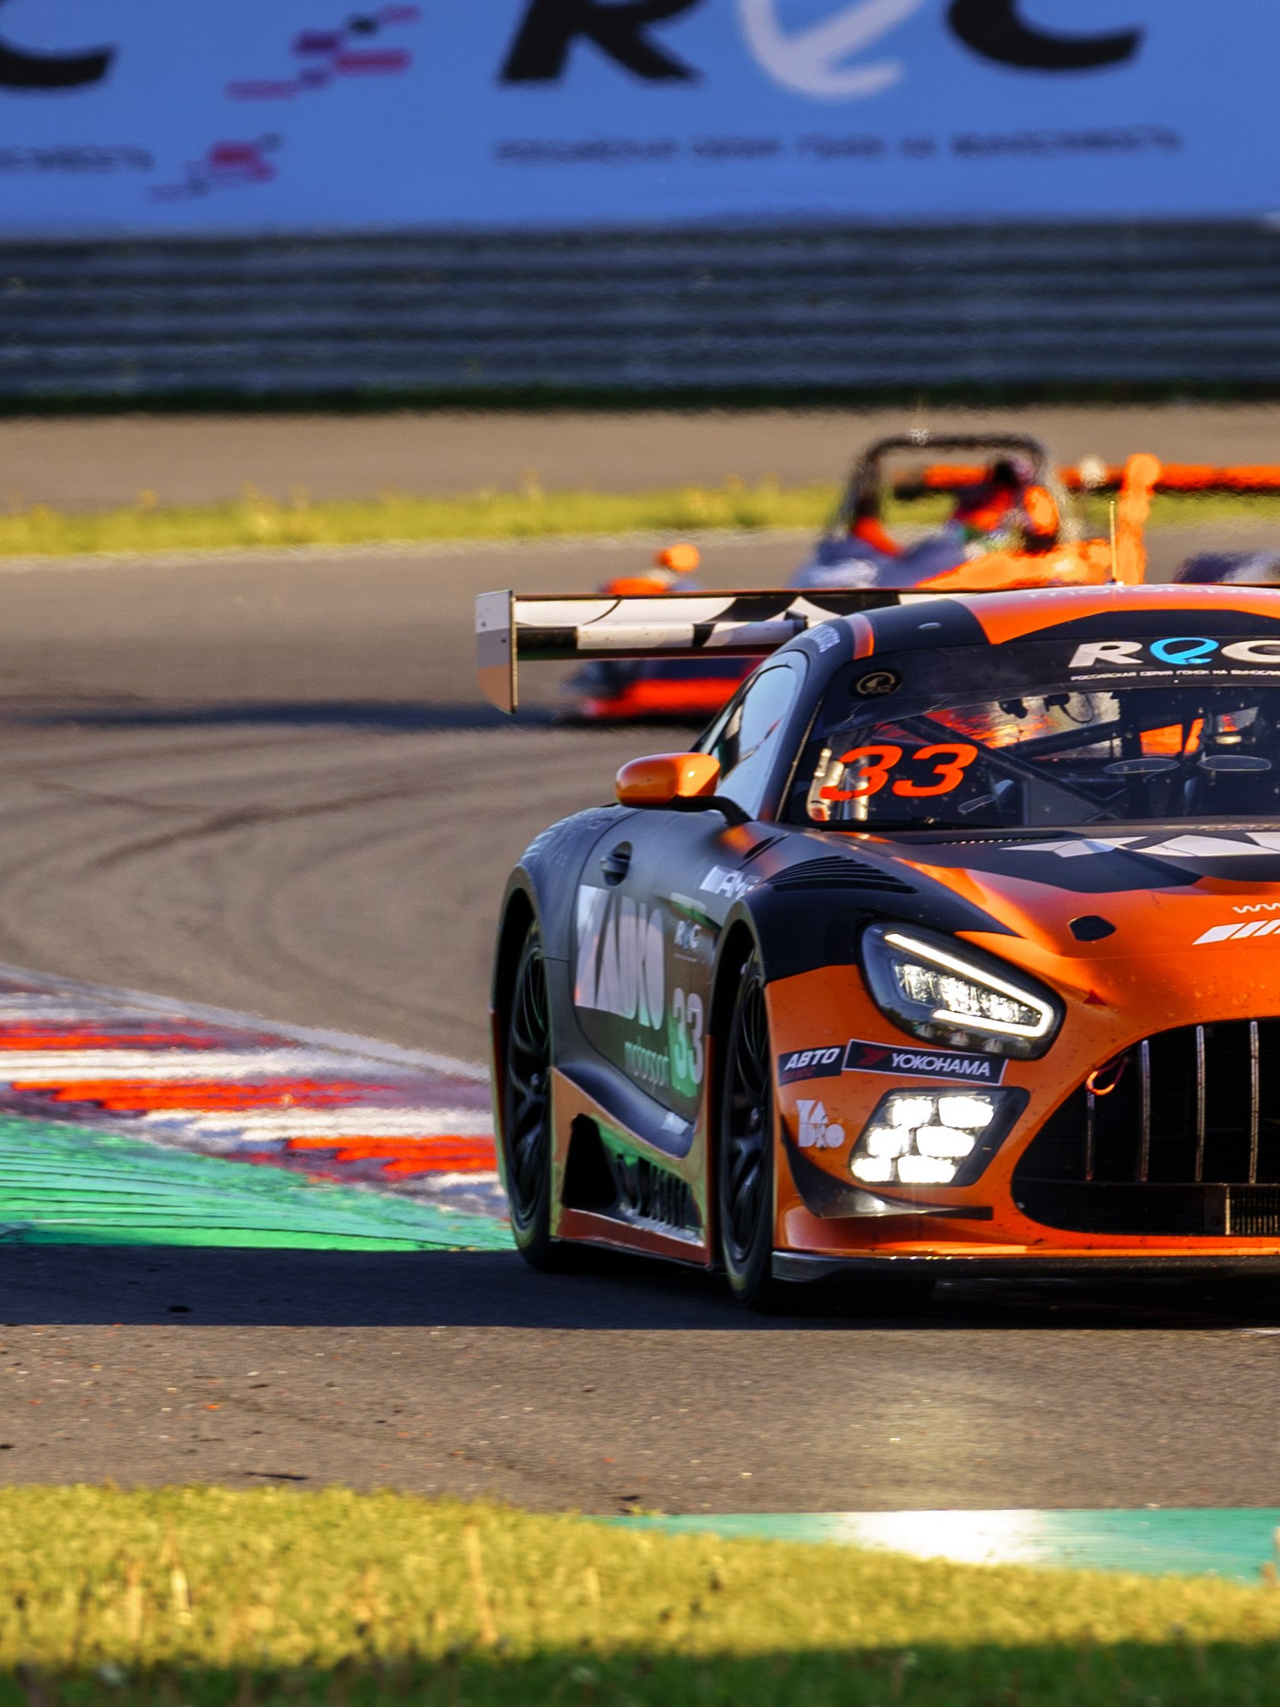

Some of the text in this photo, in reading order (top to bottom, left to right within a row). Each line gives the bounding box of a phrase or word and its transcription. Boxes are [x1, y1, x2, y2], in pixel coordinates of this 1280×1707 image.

[820, 744, 978, 800] 33
[673, 987, 704, 1084] 33
[892, 1053, 990, 1077] YOKOHAMA
